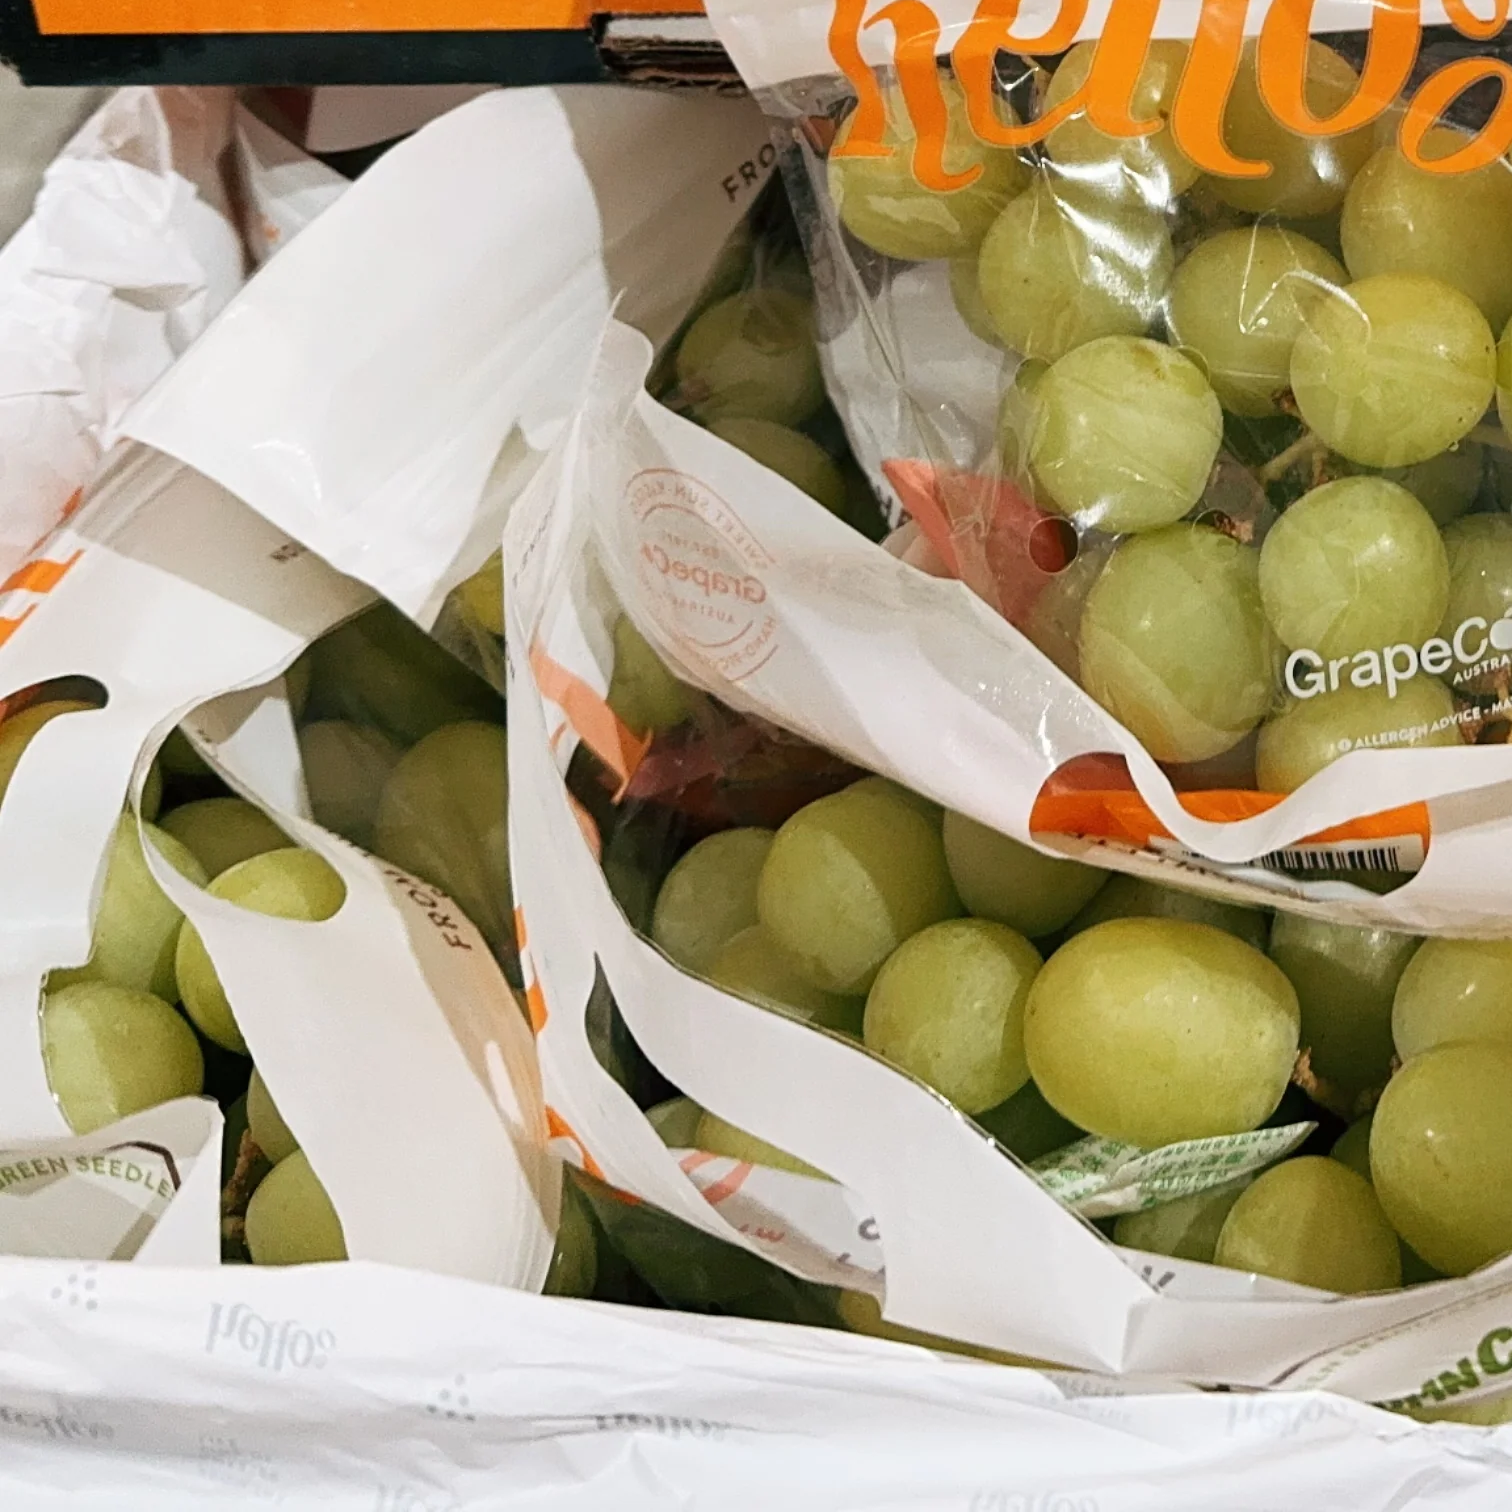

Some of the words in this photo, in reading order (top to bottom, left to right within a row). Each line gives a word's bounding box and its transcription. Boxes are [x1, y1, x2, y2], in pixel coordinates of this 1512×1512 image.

[721, 142, 777, 204] FRO
[1353, 723, 1428, 750] ALLERGEN
[1430, 706, 1481, 733] ADVICE
[0, 1155, 70, 1189] REEN
